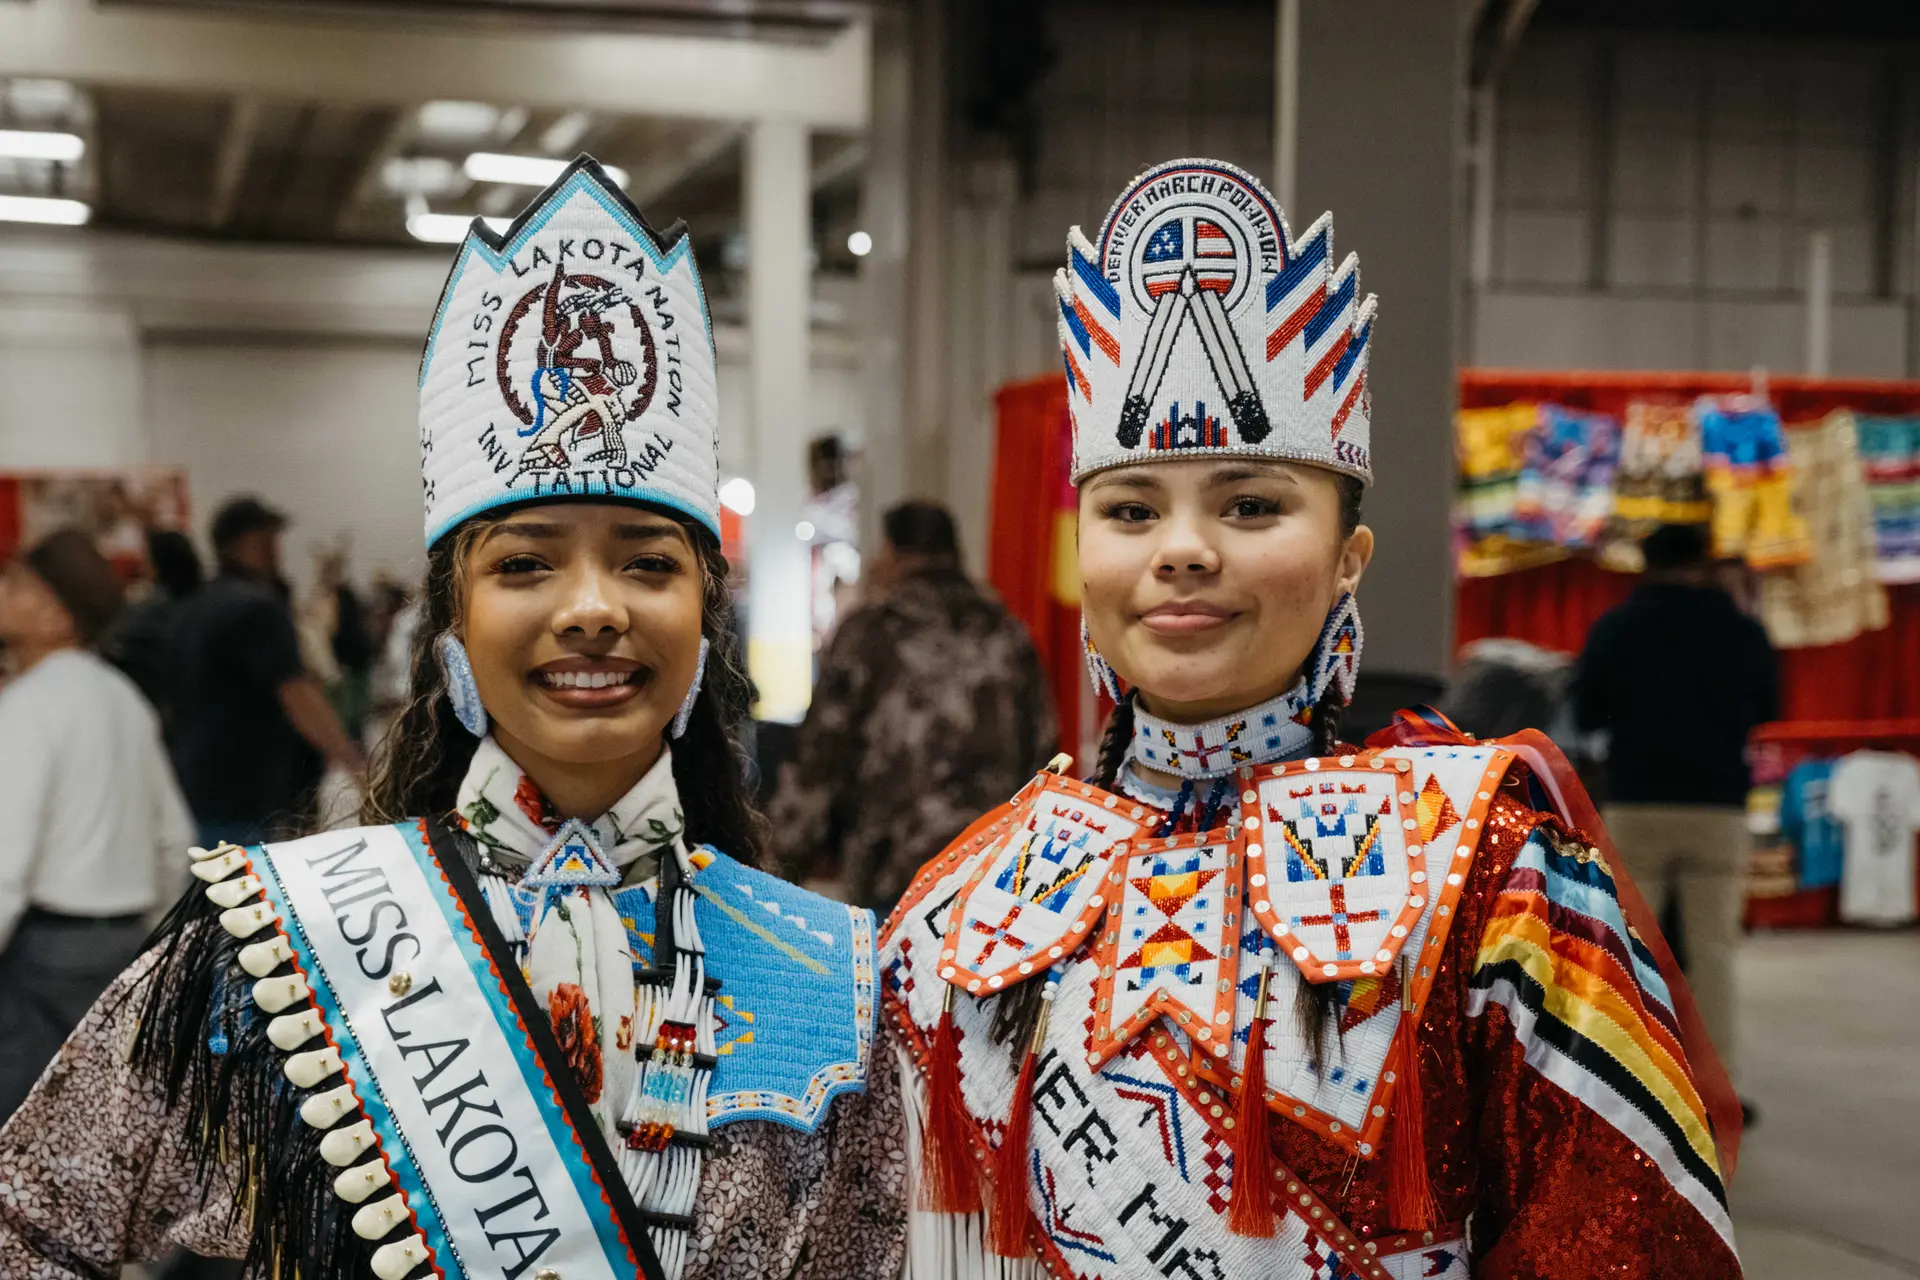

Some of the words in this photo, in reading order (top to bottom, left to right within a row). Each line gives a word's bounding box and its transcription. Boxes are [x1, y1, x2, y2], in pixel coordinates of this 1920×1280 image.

[1107, 199, 1146, 283] DENVER
[1143, 175, 1216, 205] MARCH
[466, 290, 504, 388] MISS
[508, 238, 646, 281] LAKOTA
[645, 285, 683, 418] NATION
[477, 422, 674, 495] INVITATIONAL
[305, 836, 421, 981] MISS
[380, 975, 562, 1280] LAKOTA
